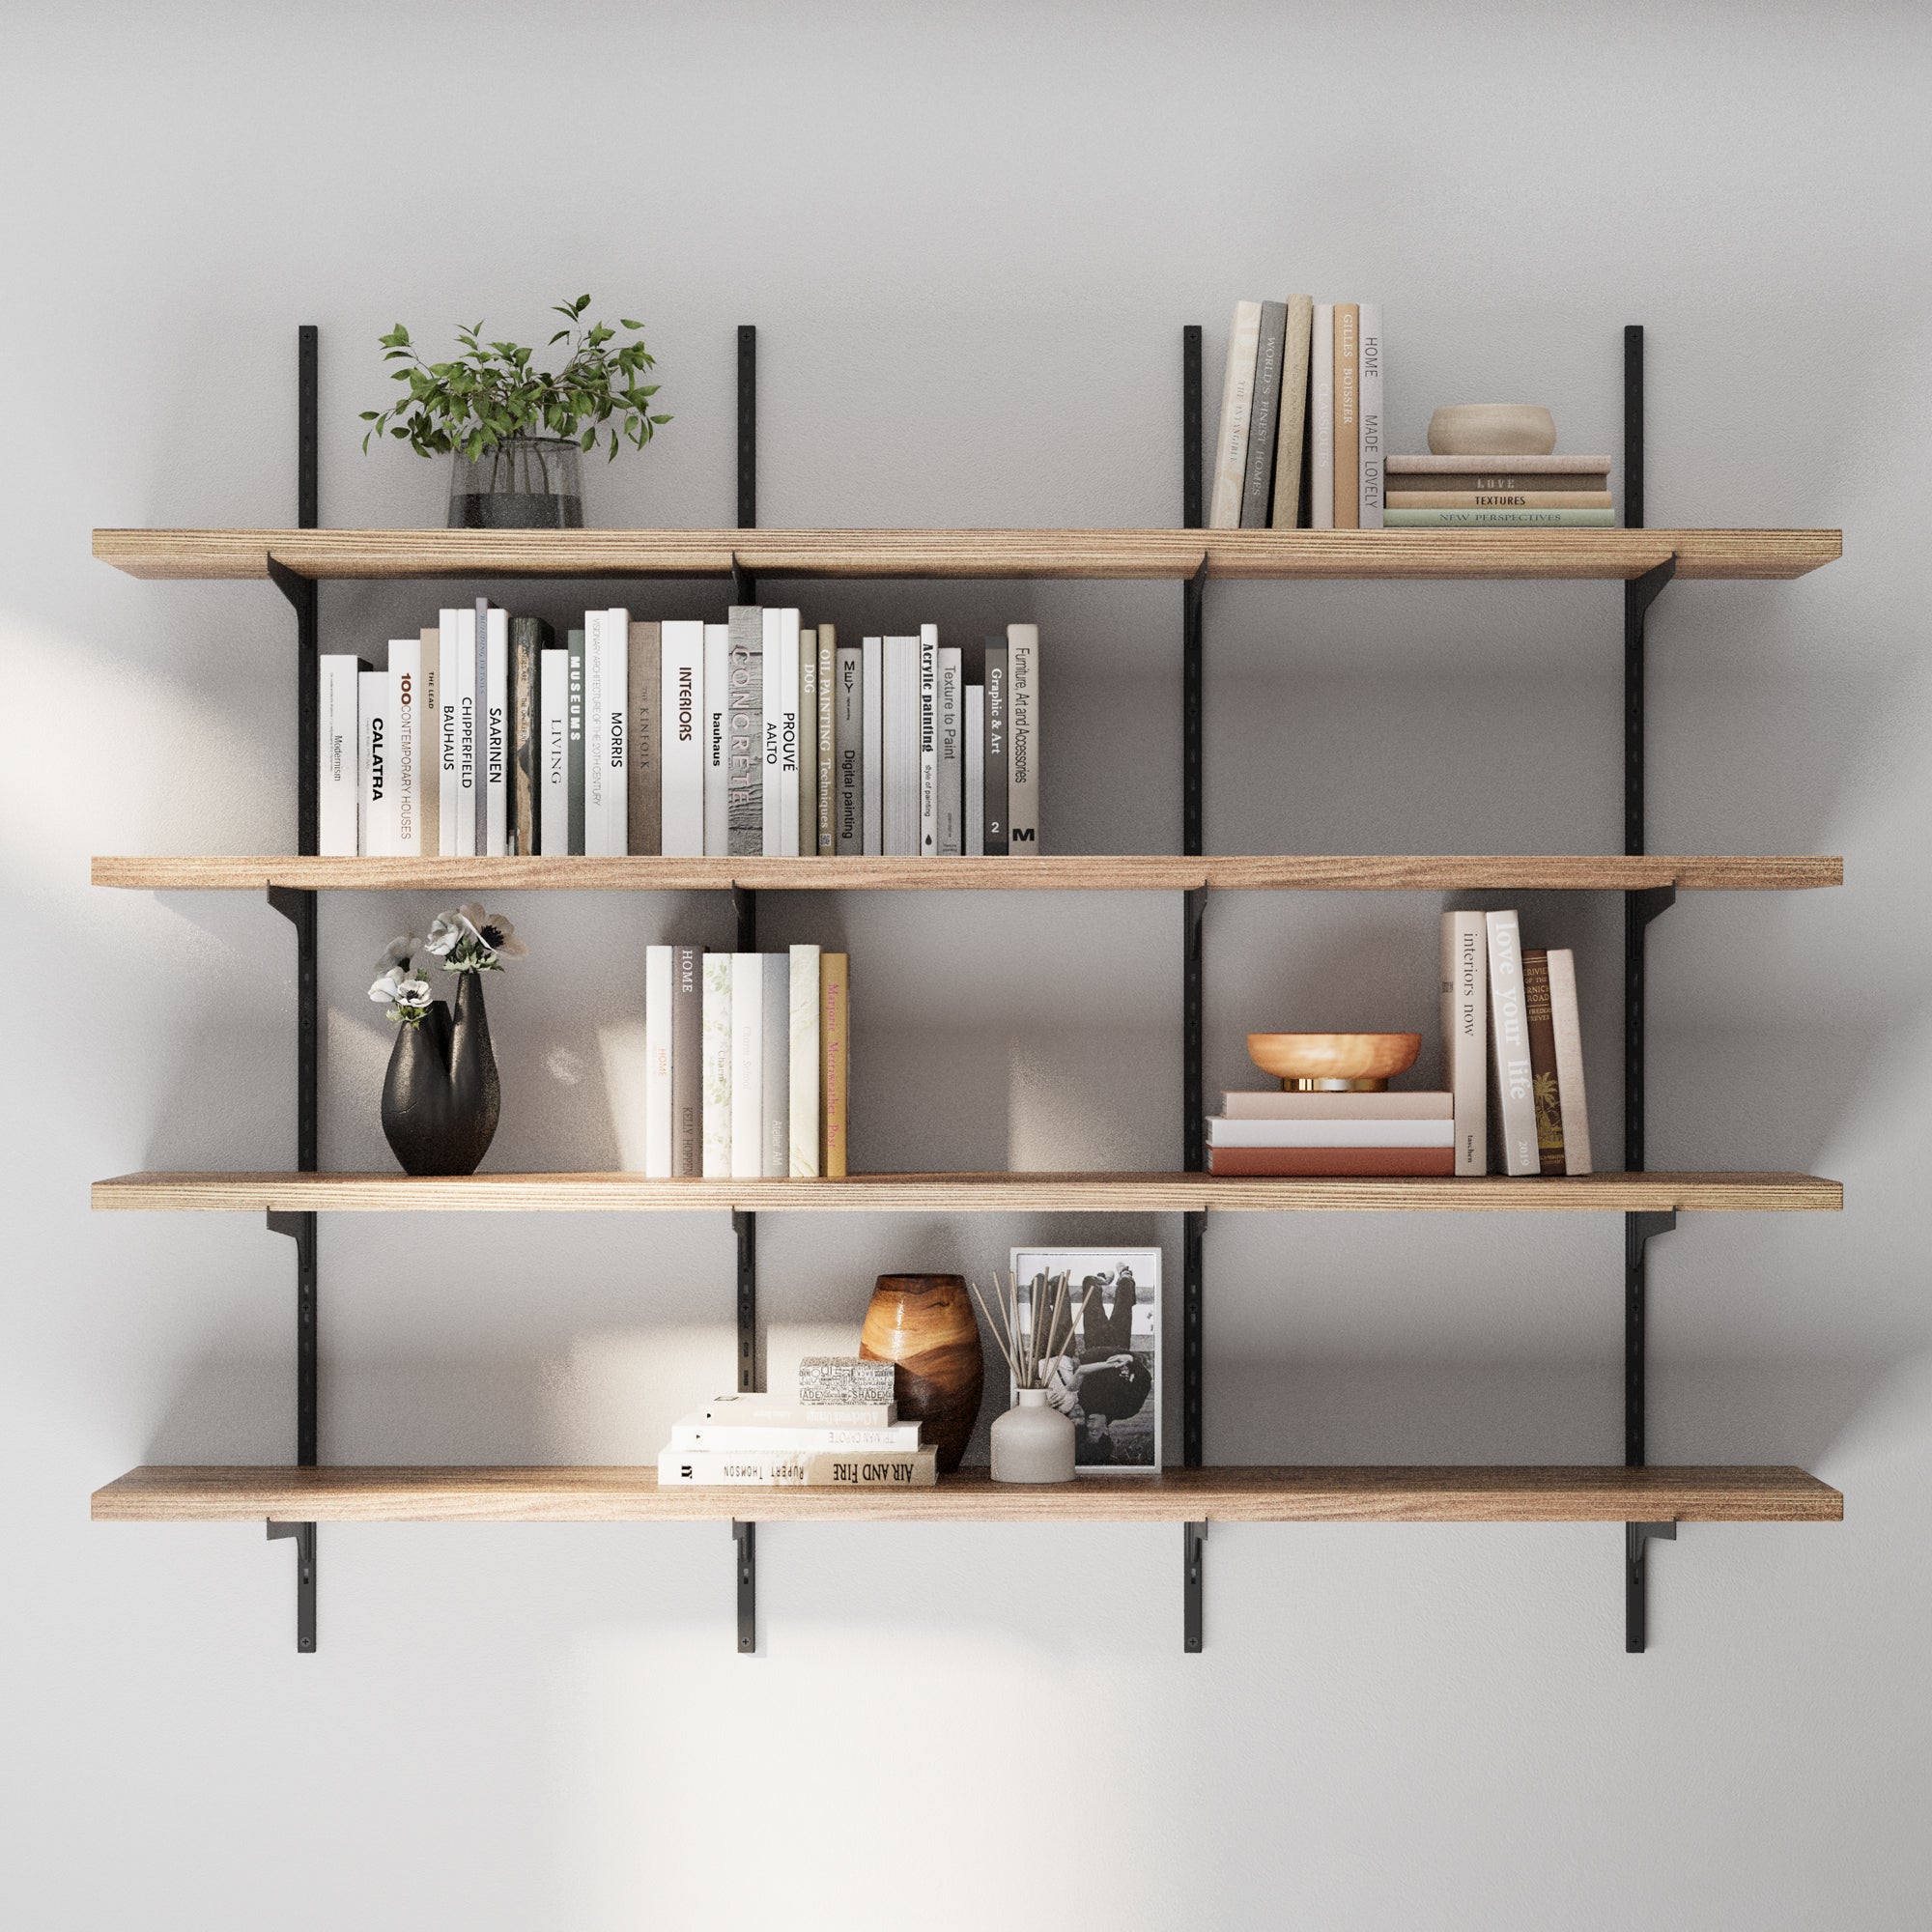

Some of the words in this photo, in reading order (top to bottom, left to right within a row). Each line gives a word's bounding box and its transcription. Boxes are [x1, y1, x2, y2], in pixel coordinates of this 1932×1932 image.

[1344, 314, 1352, 357] GILLES
[1365, 338, 1378, 377] HOME
[1344, 368, 1352, 424] BOISSIER
[1258, 402, 1268, 443] FINEST
[1365, 415, 1378, 452] MADE
[1253, 451, 1264, 496] HOMES
[1365, 462, 1378, 508] LOVELY
[1478, 479, 1515, 488] LOVE
[1475, 497, 1525, 505] TEXTURES
[805, 664, 814, 693] DOG
[820, 649, 831, 676] OIL
[923, 643, 934, 689] Acrylic
[1014, 648, 1030, 690] Furniture,
[571, 656, 581, 740] MUSEUMS
[679, 668, 692, 741] INTERIORS
[945, 666, 955, 709] Texture
[990, 668, 1002, 716] Graphic
[1015, 693, 1029, 706] Art
[592, 713, 600, 724] OF
[731, 646, 751, 804] CONCRETE
[820, 679, 831, 751] PAINTING
[922, 696, 934, 752] painting
[945, 713, 955, 724] to
[991, 720, 1001, 729] &
[1015, 708, 1029, 725] and
[334, 735, 343, 781] Modernism
[443, 705, 454, 770] BAUHAUS
[462, 697, 471, 788] CHIPPERFIELD
[490, 708, 501, 783] SAARINEN
[552, 720, 561, 784] LIVING
[611, 713, 622, 767] MORRIS
[639, 707, 649, 769] KINFOLK
[713, 713, 722, 766] bauhaus
[767, 723, 777, 764] AALTO
[783, 713, 798, 771] PROUVÉ
[945, 729, 955, 759] Paint
[991, 733, 1002, 753] Art
[1015, 728, 1029, 783] Accessories
[373, 718, 384, 801] CALATRA
[843, 750, 855, 787] Digital
[923, 765, 932, 781] style
[819, 758, 831, 828] Techniques
[401, 796, 411, 839] HOUSES
[842, 791, 855, 838] painting
[992, 822, 999, 833] 2
[1012, 828, 1035, 841] M
[1463, 933, 1478, 996] interiors
[1495, 922, 1517, 974] love
[682, 951, 693, 993] HOME
[826, 984, 838, 1032] Marjorie
[1464, 1005, 1475, 1036] now
[1495, 987, 1520, 1046] your
[743, 1026, 752, 1055] Charm
[718, 1051, 726, 1082] Charm
[743, 1061, 752, 1090] School
[828, 1042, 838, 1115] Merriweather
[1507, 1059, 1530, 1099] life
[683, 1107, 693, 1134] KELLY
[773, 1121, 782, 1147] Atelier
[828, 1124, 838, 1148] Post
[683, 1140, 693, 1175] HOPPEN
[773, 1151, 782, 1165] AM
[1519, 1140, 1529, 1166] 2019
[724, 1465, 763, 1480] THOMSON
[771, 1465, 804, 1480] RUPERT
[834, 1463, 858, 1483] FIRE
[864, 1464, 889, 1483] AND
[892, 1464, 913, 1483] AIR
